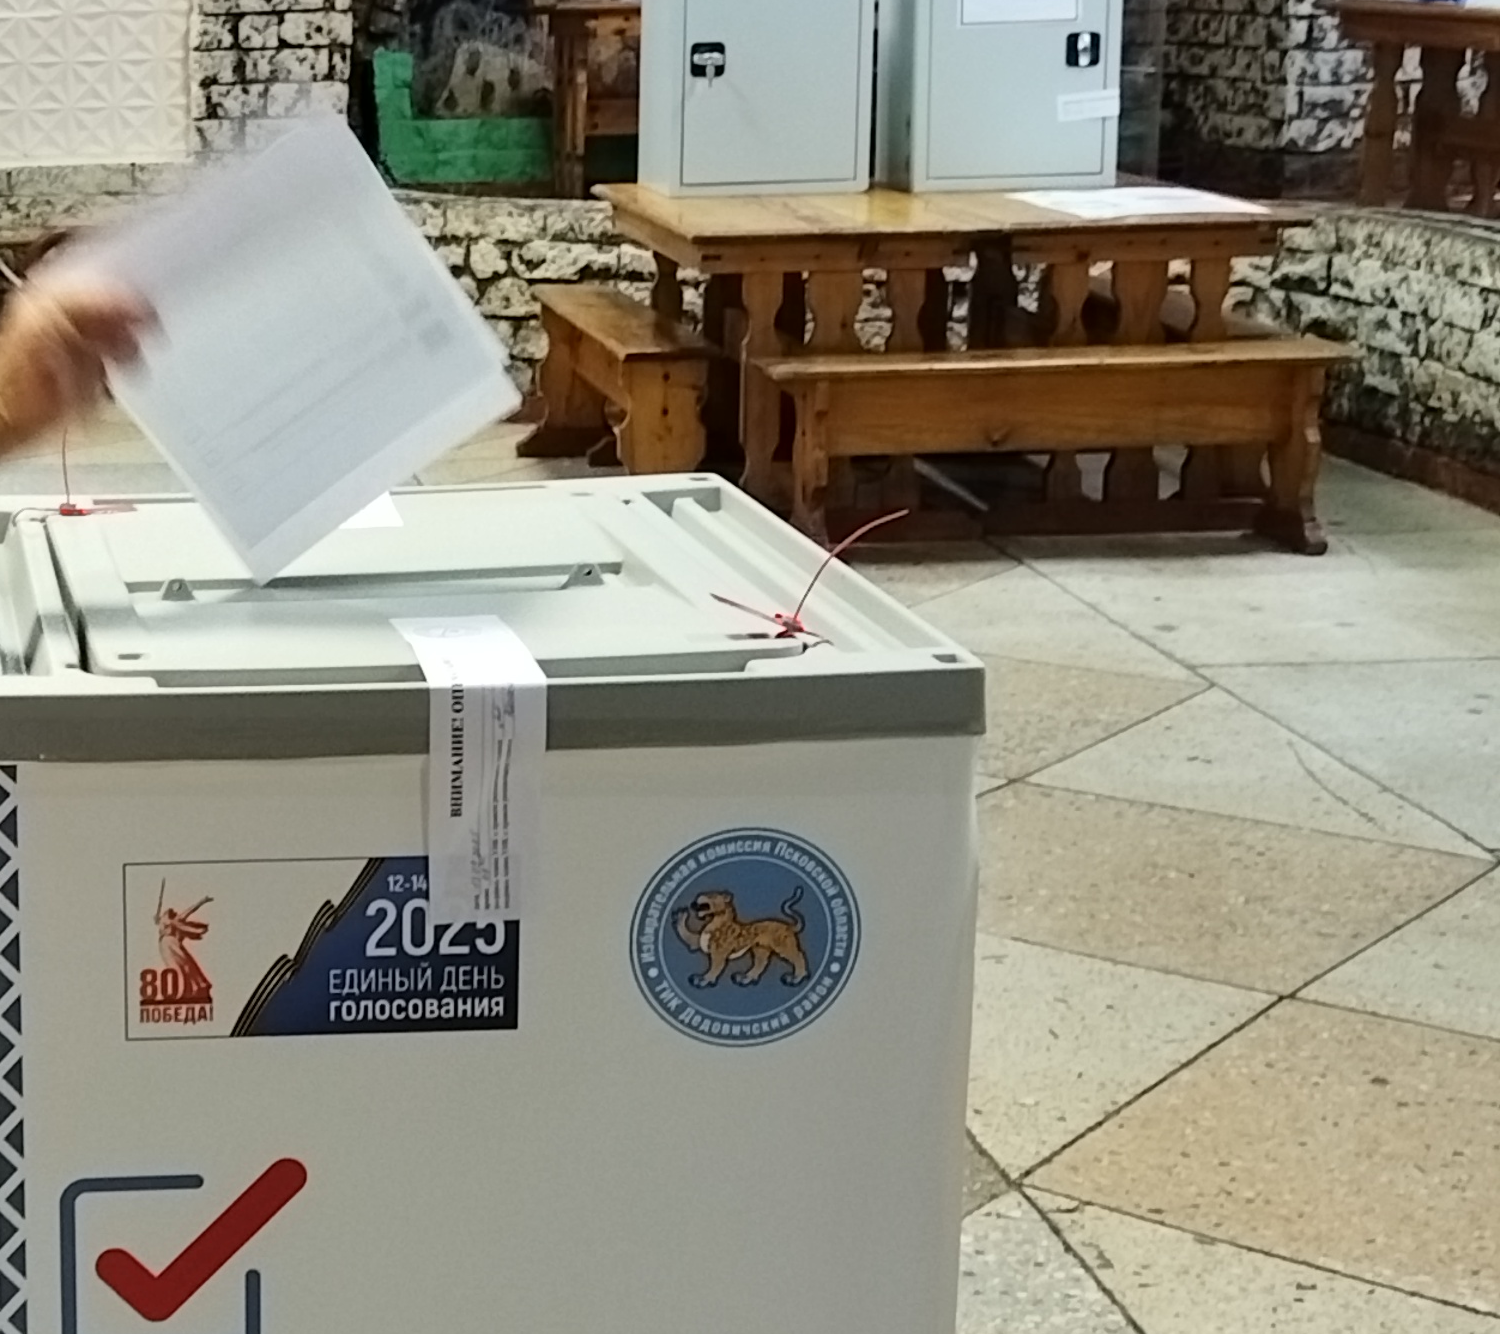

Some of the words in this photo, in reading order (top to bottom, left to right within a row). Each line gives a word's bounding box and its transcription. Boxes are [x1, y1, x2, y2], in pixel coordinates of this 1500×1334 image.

[387, 873, 428, 893] 12-14
[640, 857, 699, 964] Избирательная
[697, 839, 773, 865] комиссия
[773, 841, 841, 898] Псковской
[830, 897, 849, 959] области
[140, 968, 179, 1000] 80
[328, 961, 433, 996] ЕДИНЫЙ
[439, 965, 505, 993] ДЕНЬ
[139, 1004, 214, 1025] ПОБЕДА!
[329, 996, 505, 1022] голосования
[654, 978, 682, 1012] ТИК
[678, 1007, 791, 1037] Дедовичский
[793, 975, 835, 1021] район
